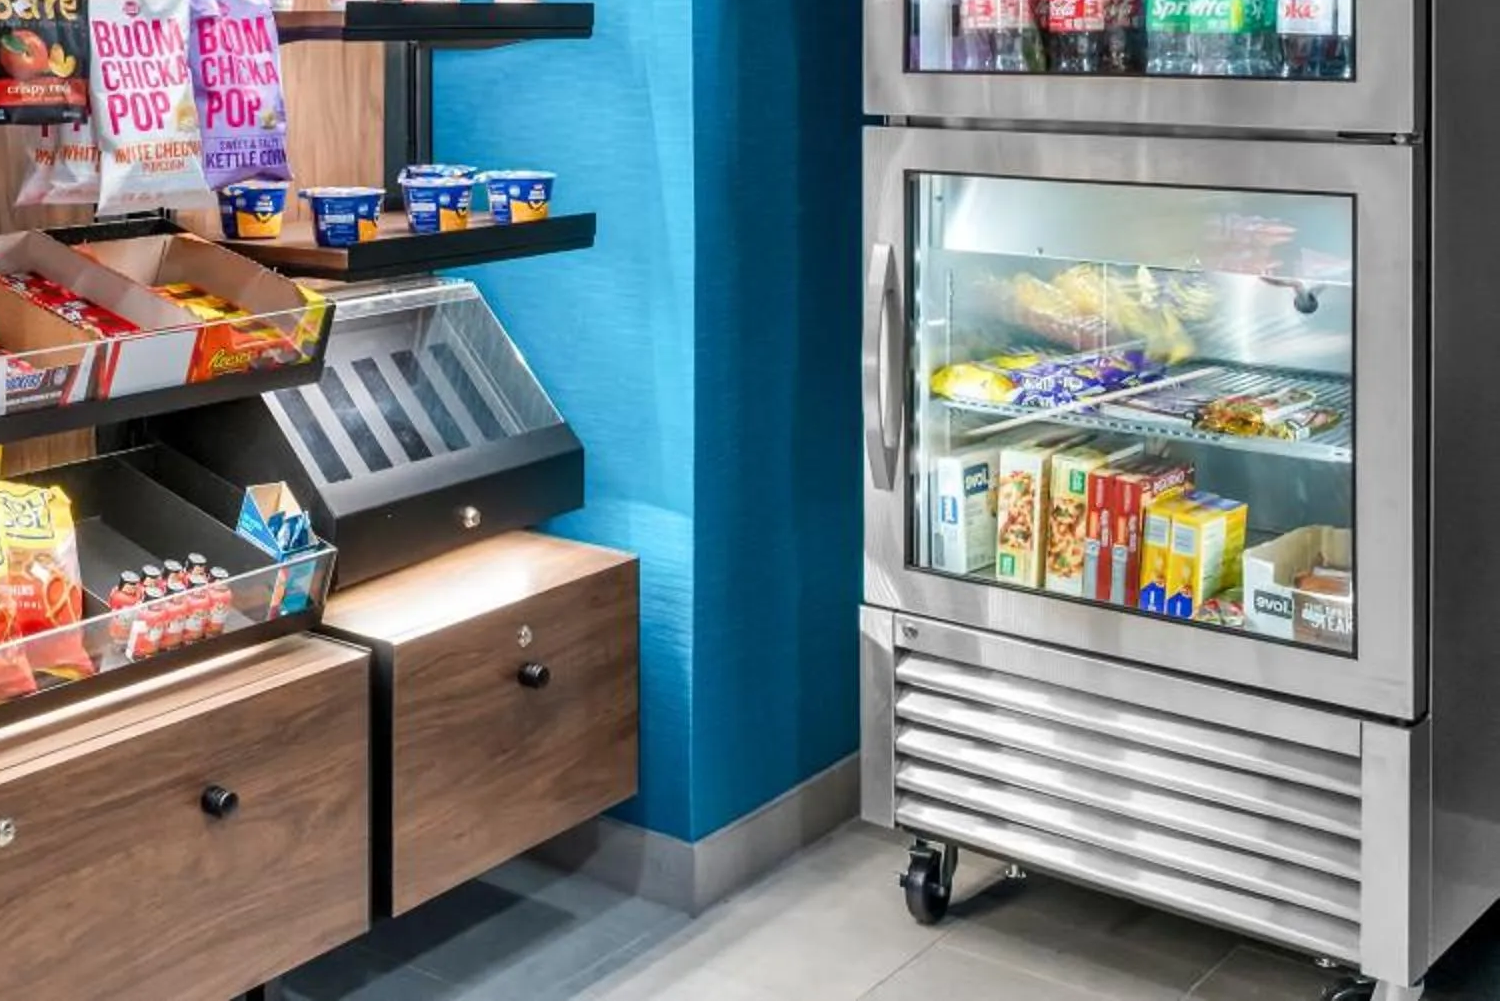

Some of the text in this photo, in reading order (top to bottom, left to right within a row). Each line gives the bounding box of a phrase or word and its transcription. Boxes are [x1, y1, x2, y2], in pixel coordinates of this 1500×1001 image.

[100, 57, 189, 92] CHICKA
[107, 92, 172, 136] POP
[206, 88, 261, 129] POP
[205, 151, 257, 169] KETTLE
